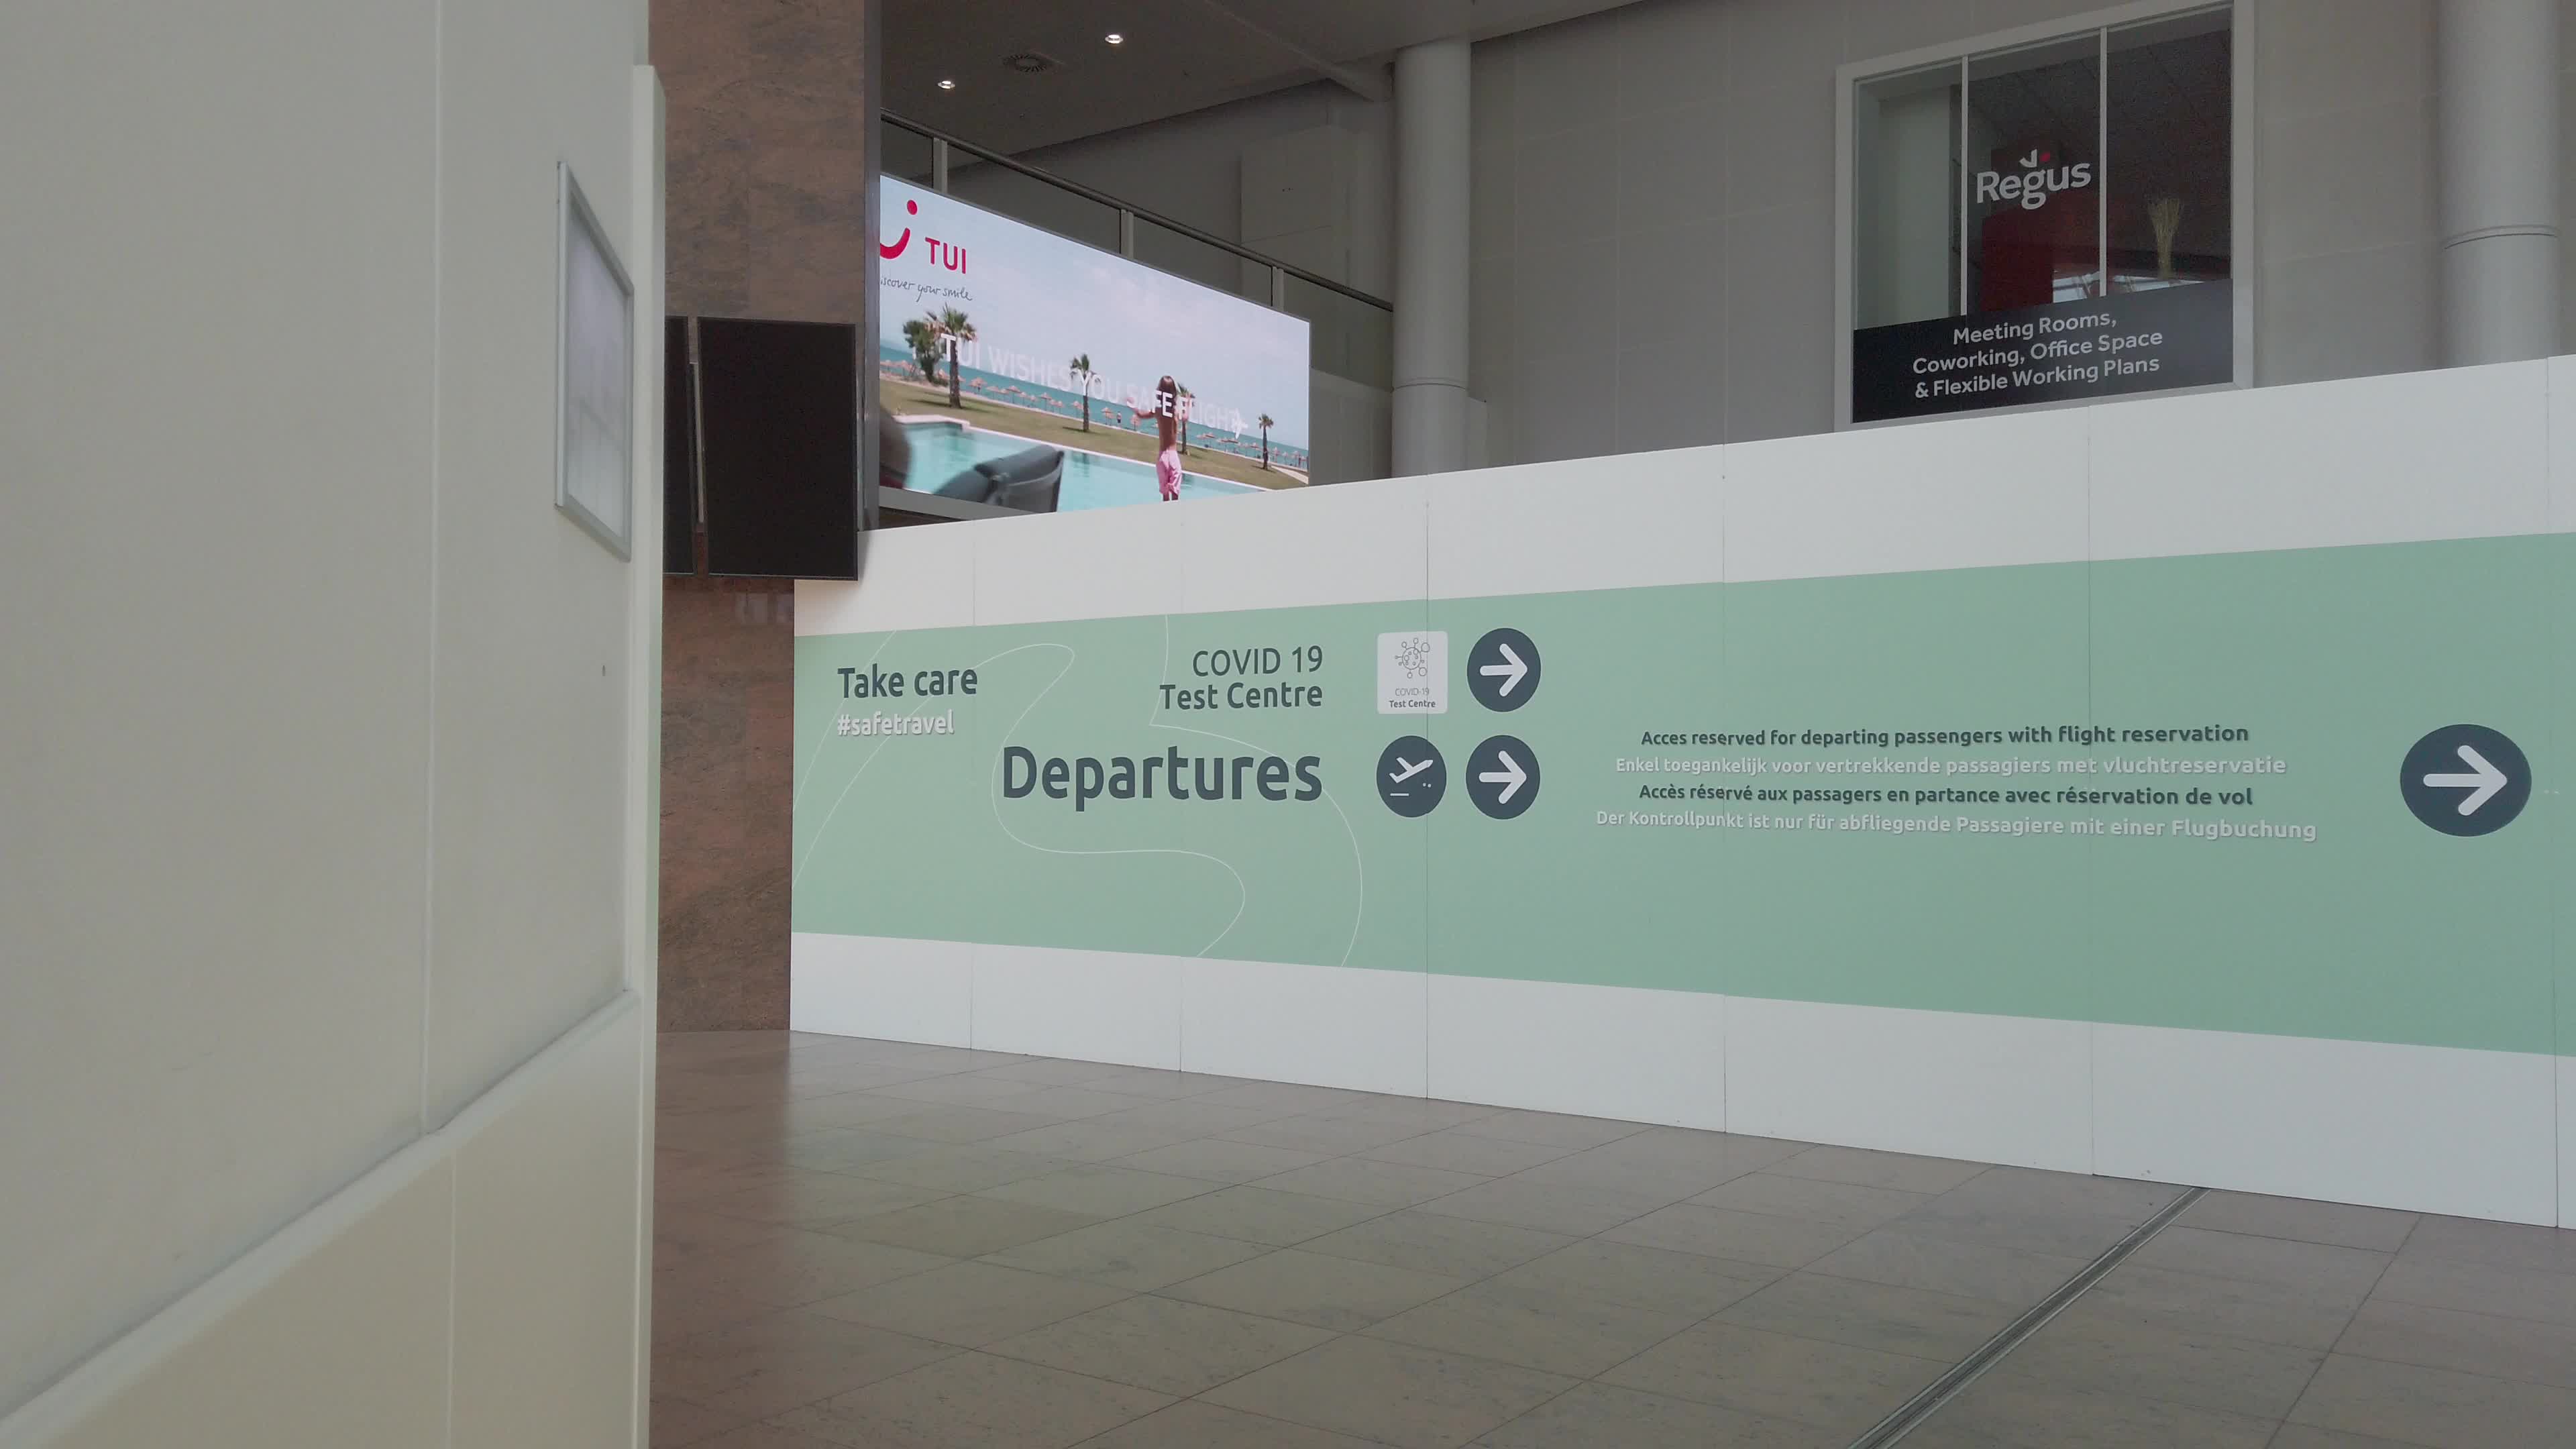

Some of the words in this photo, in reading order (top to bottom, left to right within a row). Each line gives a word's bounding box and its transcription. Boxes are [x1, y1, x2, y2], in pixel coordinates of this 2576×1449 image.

[1977, 162, 2091, 209] Regus
[925, 237, 966, 274] TUI
[879, 277, 914, 290] iscover
[918, 284, 940, 303] your
[943, 286, 972, 301] smile
[1953, 322, 2033, 345] Meeting
[2039, 313, 2116, 334] Rooms,
[1913, 349, 2025, 374] Coworking,
[2030, 339, 2093, 360] Office
[2098, 332, 2163, 354] Space
[941, 333, 980, 368] TUI
[987, 343, 1071, 391] WISHES
[1076, 369, 1121, 403] YOU
[1127, 382, 1173, 418] SAFE
[1915, 382, 1929, 398] &
[1933, 373, 2008, 396] Flexible
[2012, 365, 2098, 387] Working
[2104, 358, 2160, 376] Plans
[1192, 647, 1281, 677] COVID
[1291, 645, 1322, 673] 19
[837, 663, 904, 698] Take
[914, 669, 977, 696] care
[1160, 684, 1218, 710] Test
[1227, 682, 1322, 709] Centre
[1395, 688, 1430, 696] COVID-19
[1389, 700, 1406, 708] Test
[1408, 700, 1436, 708] Centre
[837, 708, 955, 737] #safetravel
[1641, 731, 1686, 745] Acces
[1692, 730, 1765, 745] reserved
[1770, 729, 1796, 745] for
[1801, 729, 1889, 747] departing
[1894, 729, 2002, 747] passengers
[2008, 726, 2051, 743] with
[2058, 725, 2115, 746] flight
[2121, 724, 2249, 742] reservation
[1004, 745, 1322, 812] Departures
[1616, 757, 1660, 772] Enkel
[1664, 756, 1767, 776] toegankelijk
[1772, 760, 1813, 773] voor
[1815, 756, 1941, 773] vertrekkende
[1947, 756, 2051, 776] passagiers
[2057, 757, 2099, 773] met
[2103, 755, 2287, 773] vluchtreservatie
[1639, 784, 1684, 799] Accès
[1690, 784, 1752, 800] réservé
[1758, 788, 1788, 801] aux
[1792, 788, 1882, 804] passagers
[1887, 790, 1909, 802] en
[1915, 788, 2000, 805] partance
[2005, 790, 2051, 803] avec
[2057, 786, 2179, 804] réservation
[2185, 788, 2212, 805] de
[2218, 788, 2253, 805] vol
[1597, 811, 1625, 826] Der
[1629, 810, 1744, 829] Kontrollpunkt
[1749, 813, 1770, 828] ist
[1774, 816, 1804, 830] nur
[1808, 814, 1835, 830] für
[1840, 814, 1951, 834] abfliegende
[1956, 816, 2064, 837] Passagiere
[2070, 818, 2104, 835] mit
[2110, 818, 2165, 837] einer
[2171, 818, 2317, 842] Flugbuchung
